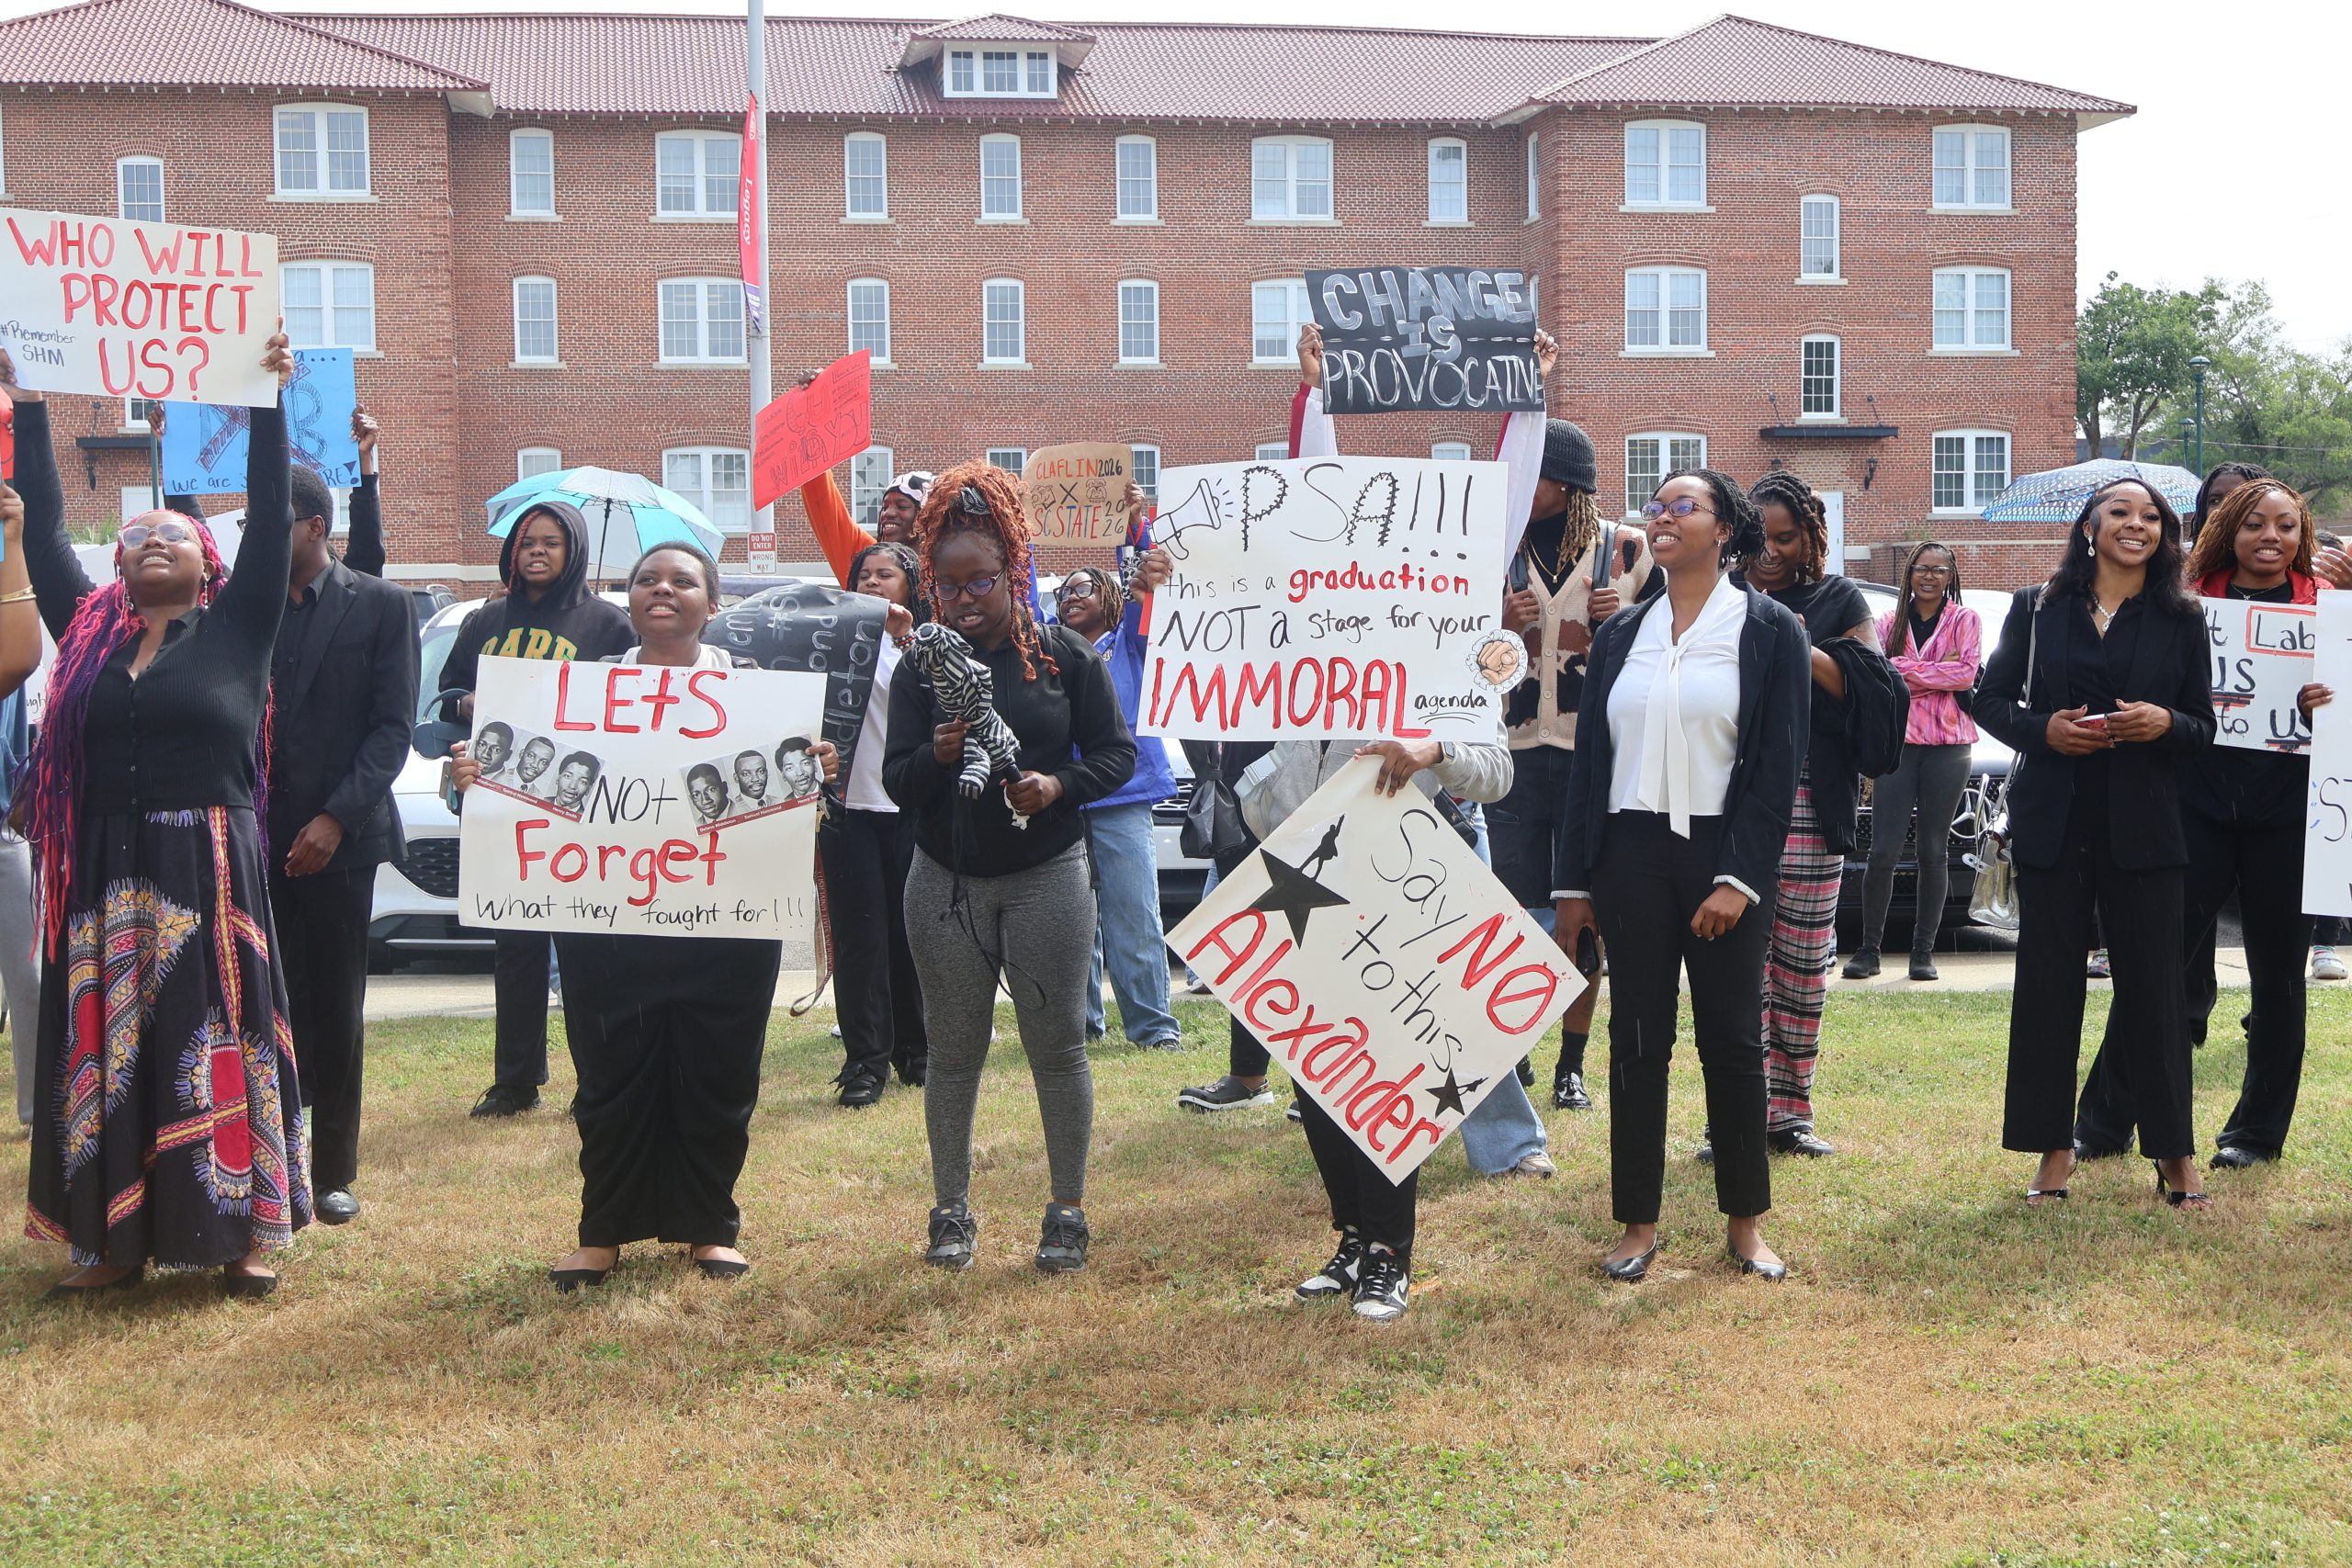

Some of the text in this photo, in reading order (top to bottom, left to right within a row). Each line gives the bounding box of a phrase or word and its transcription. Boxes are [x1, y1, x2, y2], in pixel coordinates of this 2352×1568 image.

[742, 177, 753, 245] Legacy
[7, 217, 263, 276] WHO WILL
[60, 273, 255, 334] PROTECT
[1323, 269, 1532, 331] CHANGE
[1, 320, 76, 344] #Remember
[23, 344, 64, 367] SHM
[1396, 315, 1462, 363] IS
[98, 336, 209, 400] US?
[208, 477, 232, 488] are
[1240, 462, 1473, 560] PSA!!!
[1232, 576, 1249, 593] is
[1265, 576, 1276, 590] a
[1287, 561, 1469, 603] graduation
[1158, 604, 1261, 652] NOT
[1271, 611, 1292, 644] a
[1386, 604, 1425, 630] for
[1428, 614, 1491, 650] your
[2255, 614, 2315, 650] Lab
[1148, 656, 1432, 739] IMMORAL
[1414, 689, 1489, 714] agenda
[515, 819, 727, 906] Forget
[1371, 808, 1467, 949] Say
[566, 896, 618, 928] they
[642, 900, 720, 931] fought
[1341, 914, 1463, 1074] to this
[1186, 907, 1443, 1165] Alexander
